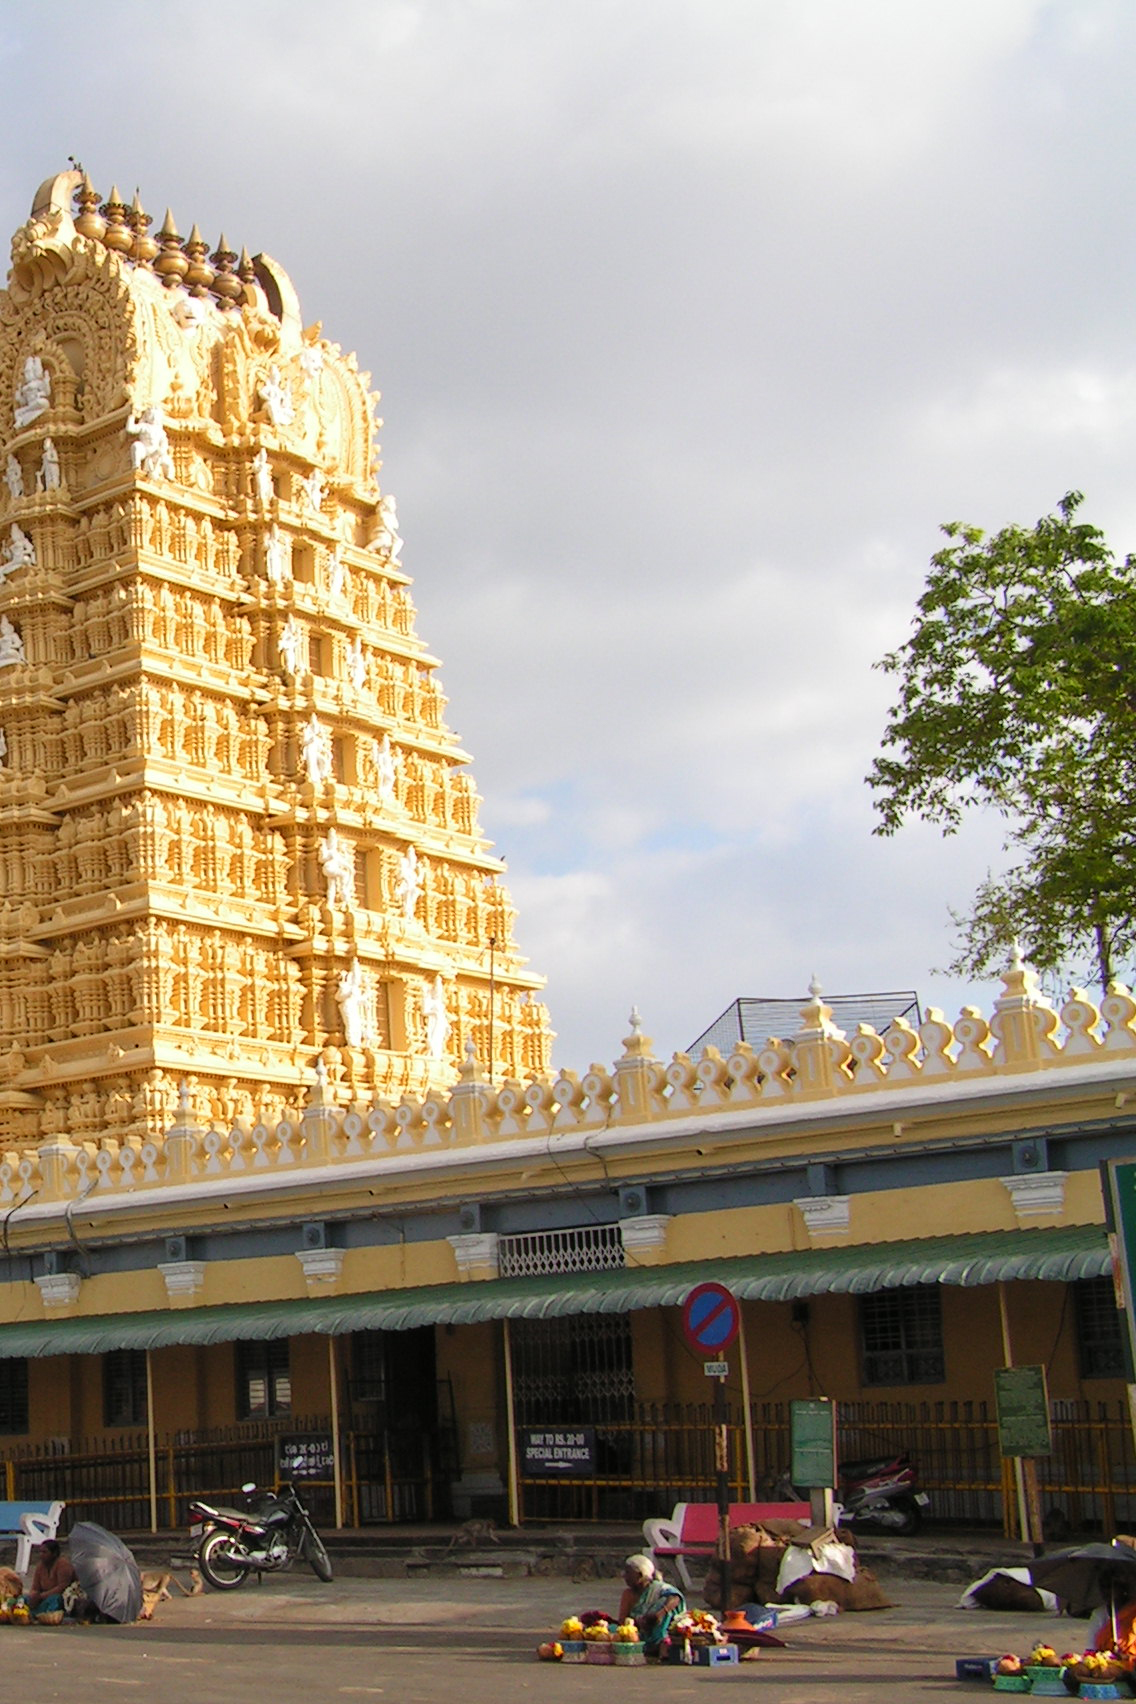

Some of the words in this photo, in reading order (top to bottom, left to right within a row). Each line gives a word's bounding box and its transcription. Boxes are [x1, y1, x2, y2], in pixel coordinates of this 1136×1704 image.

[530, 1433, 544, 1446] WAY
[545, 1433, 554, 1446] TO
[526, 1446, 553, 1459] SPECIAL
[553, 1446, 590, 1460] ENTRANCE
